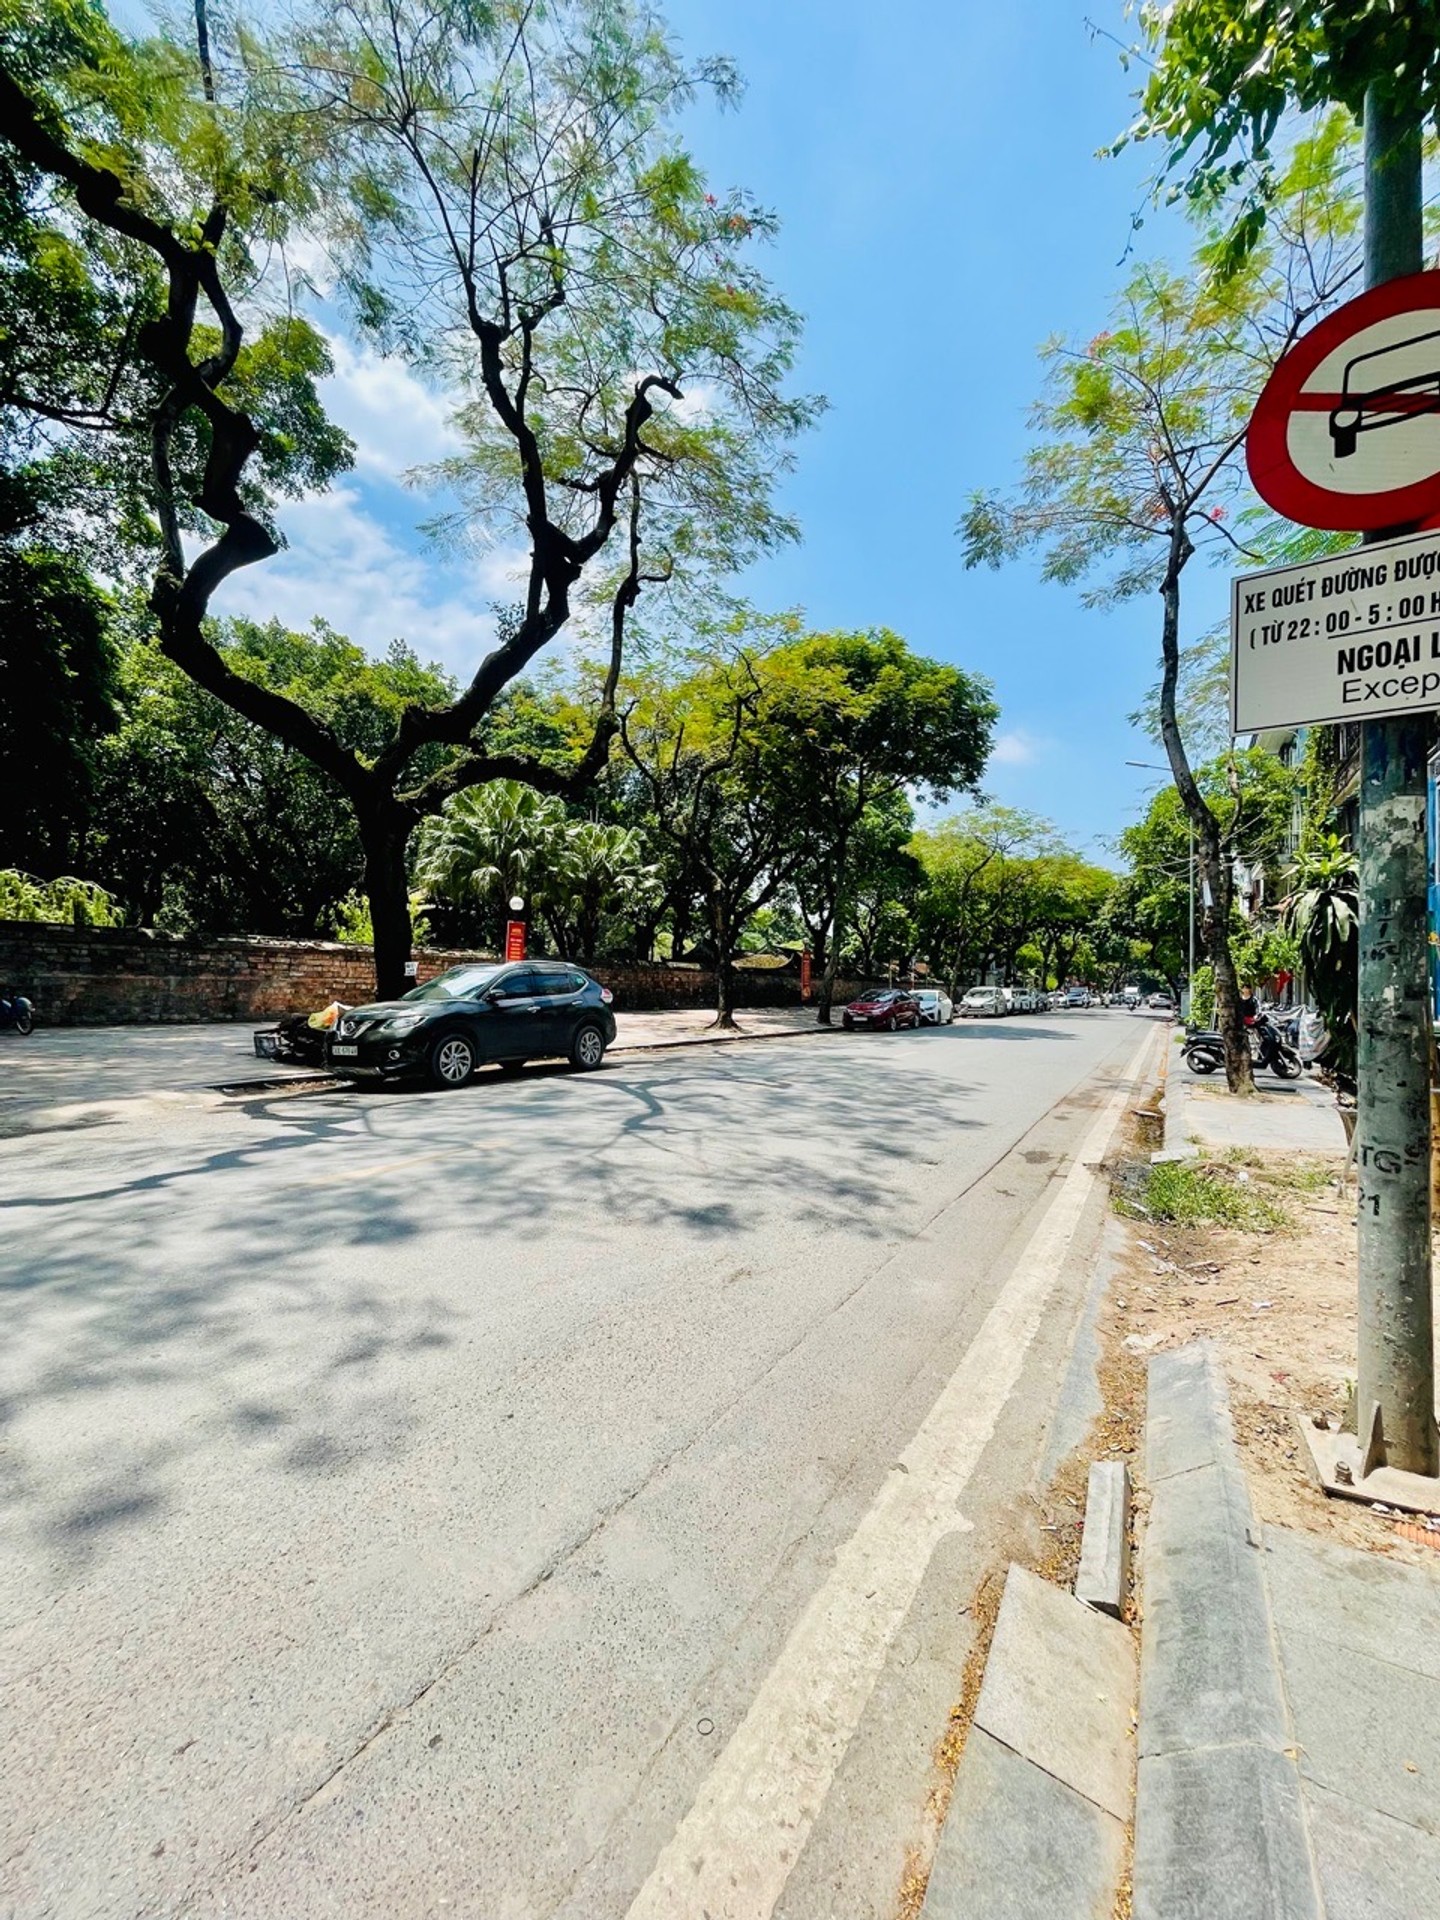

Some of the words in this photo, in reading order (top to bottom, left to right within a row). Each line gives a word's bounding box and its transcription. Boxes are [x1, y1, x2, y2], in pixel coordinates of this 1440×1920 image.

[1244, 591, 1266, 614] XE
[1272, 576, 1316, 608] QUÉT
[1321, 564, 1387, 598] ĐƯỜNG
[1337, 634, 1421, 675] NGOẠI
[1342, 672, 1440, 704] Excep
